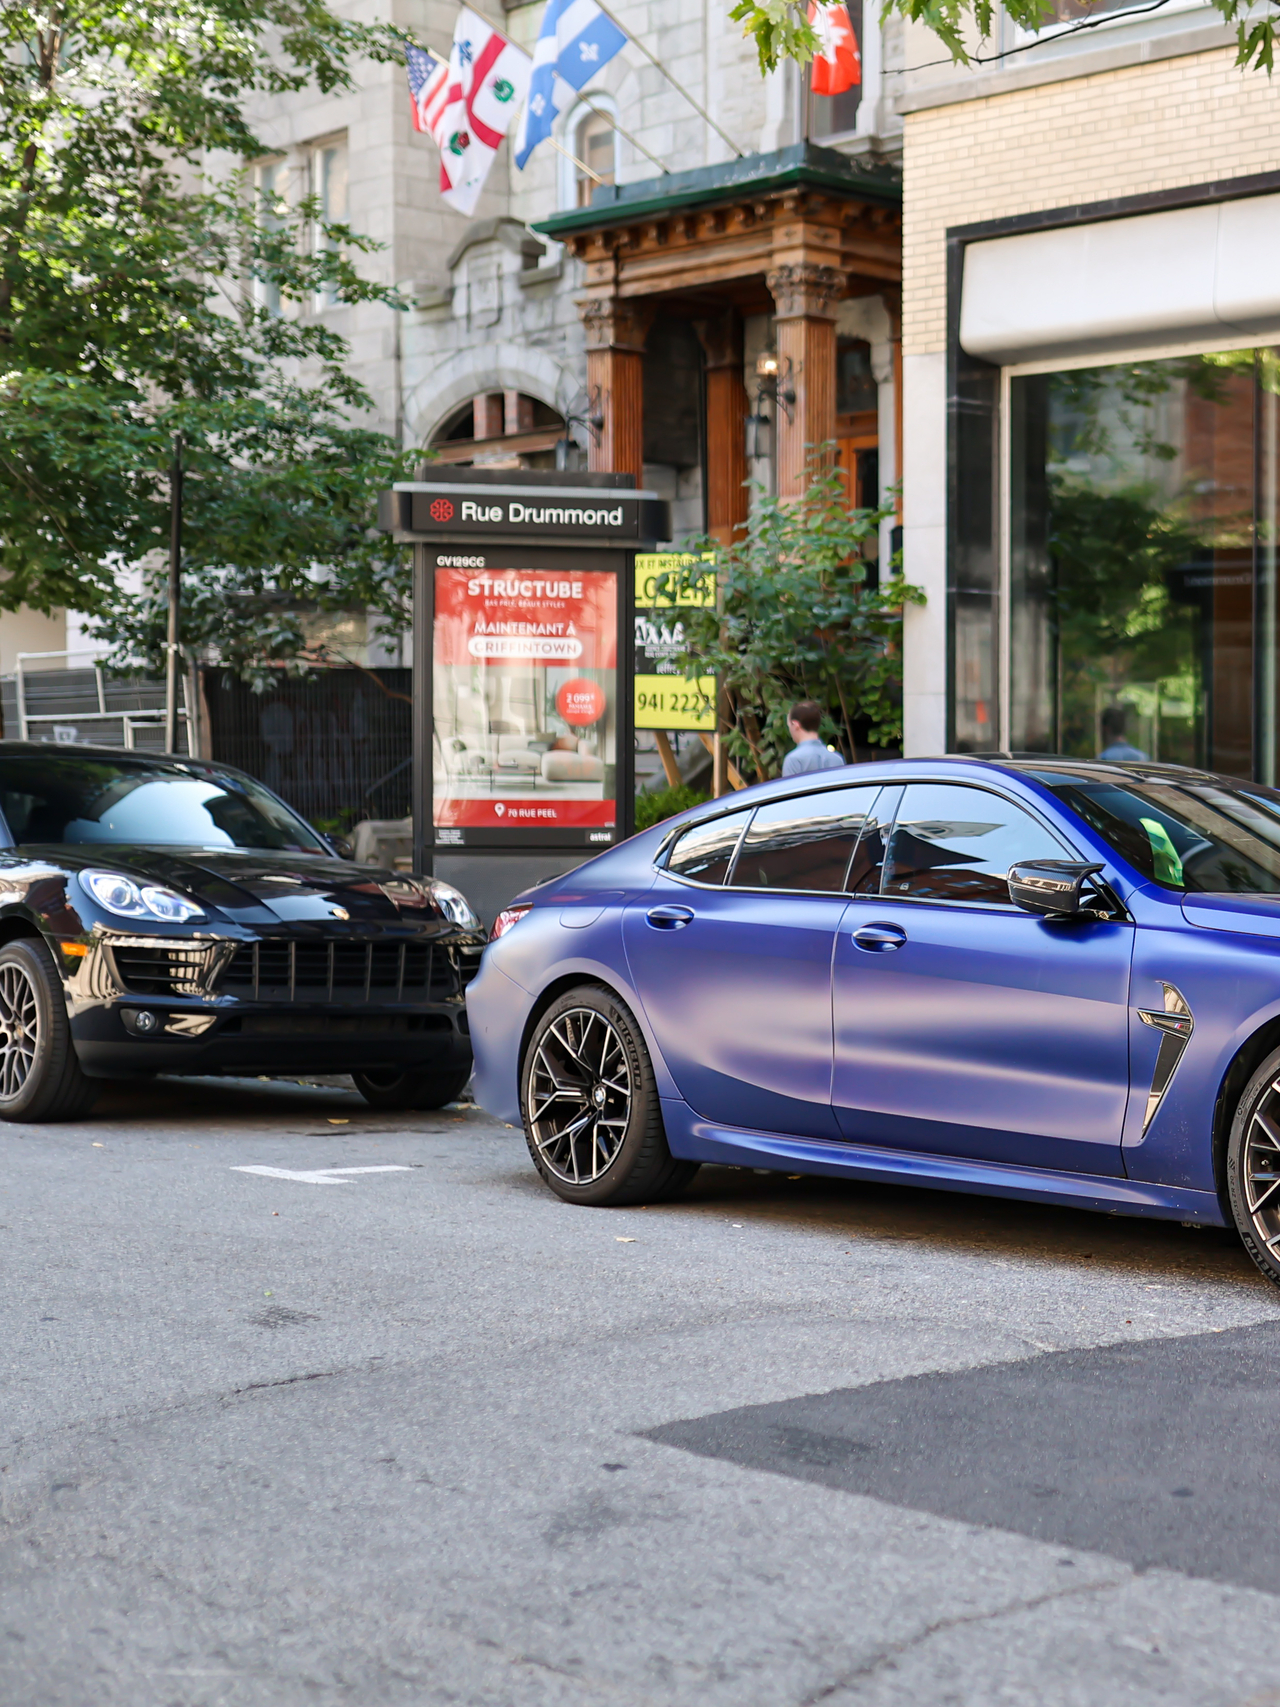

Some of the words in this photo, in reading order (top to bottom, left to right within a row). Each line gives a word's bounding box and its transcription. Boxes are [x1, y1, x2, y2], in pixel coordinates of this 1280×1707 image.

[461, 501, 503, 522] Rue
[508, 502, 623, 526] Drummond
[467, 579, 583, 599] STRUCTUBE
[474, 621, 564, 635] MAINTENANT
[566, 620, 576, 636] À
[474, 641, 577, 654] GRIFFINTOWN
[519, 808, 536, 818] RUE
[537, 808, 557, 819] PEEL
[617, 1020, 641, 1086] MICHELIN
